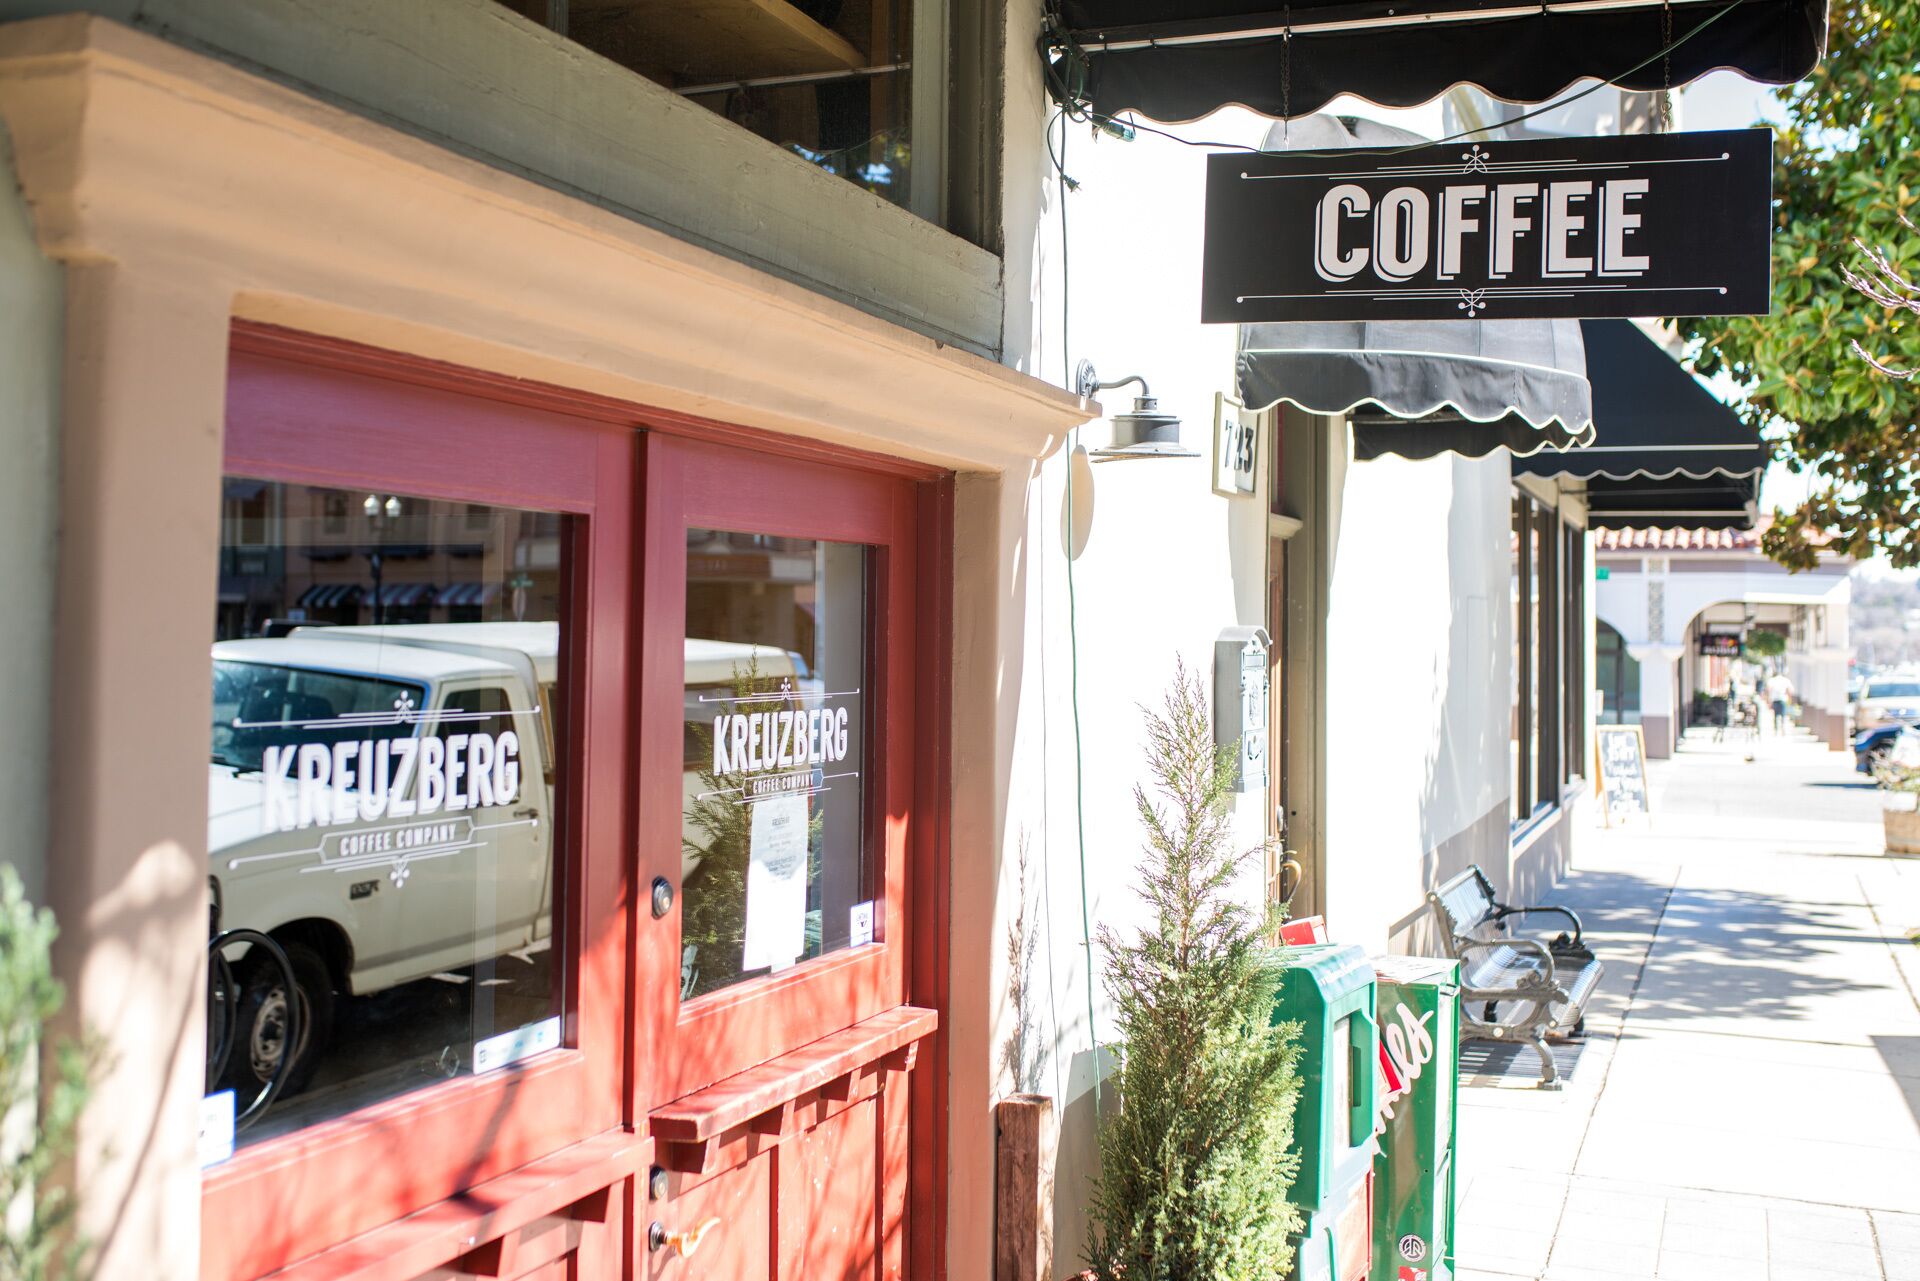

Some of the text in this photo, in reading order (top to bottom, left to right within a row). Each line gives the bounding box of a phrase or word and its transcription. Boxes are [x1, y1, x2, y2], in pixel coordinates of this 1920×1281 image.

[1314, 179, 1649, 282] COFFEE
[1225, 420, 1253, 473] 723
[713, 707, 848, 775] KREUZBERG
[263, 731, 519, 831] KREUZBERG
[753, 773, 814, 794] COFFEE COMPANY
[340, 823, 456, 857] COFFEE COMPANY
